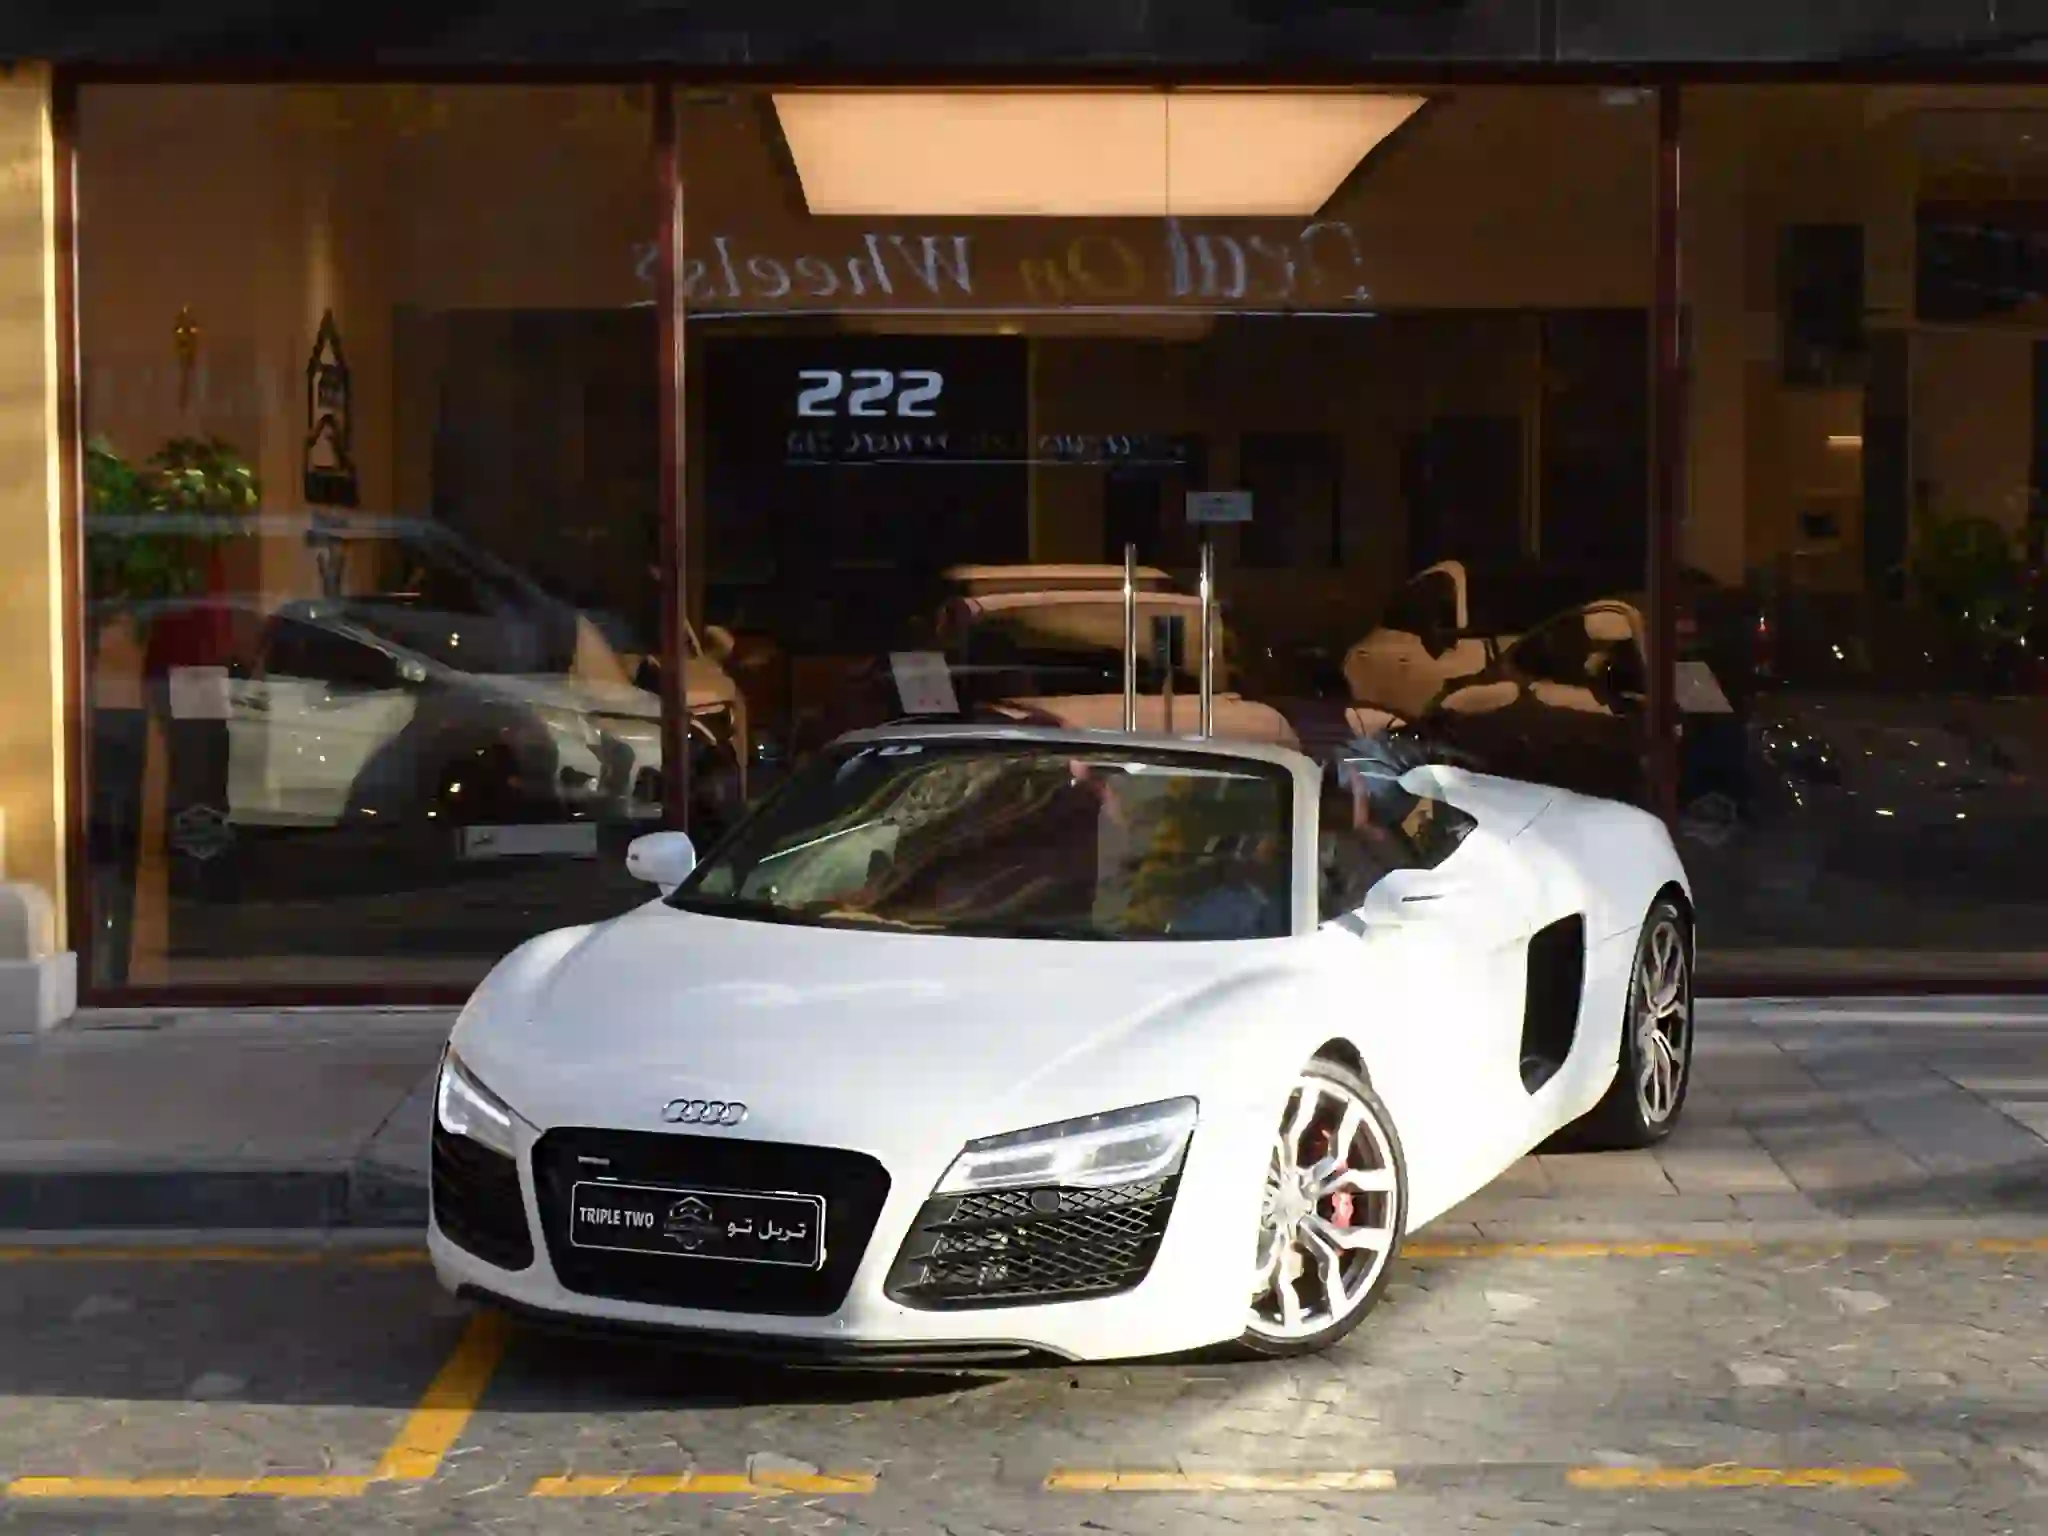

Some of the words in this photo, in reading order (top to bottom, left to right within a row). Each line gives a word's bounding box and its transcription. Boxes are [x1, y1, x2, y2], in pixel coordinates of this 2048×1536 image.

[797, 369, 943, 417] 222
[579, 1206, 621, 1225] TRIPLE
[623, 1210, 655, 1229] TWO
